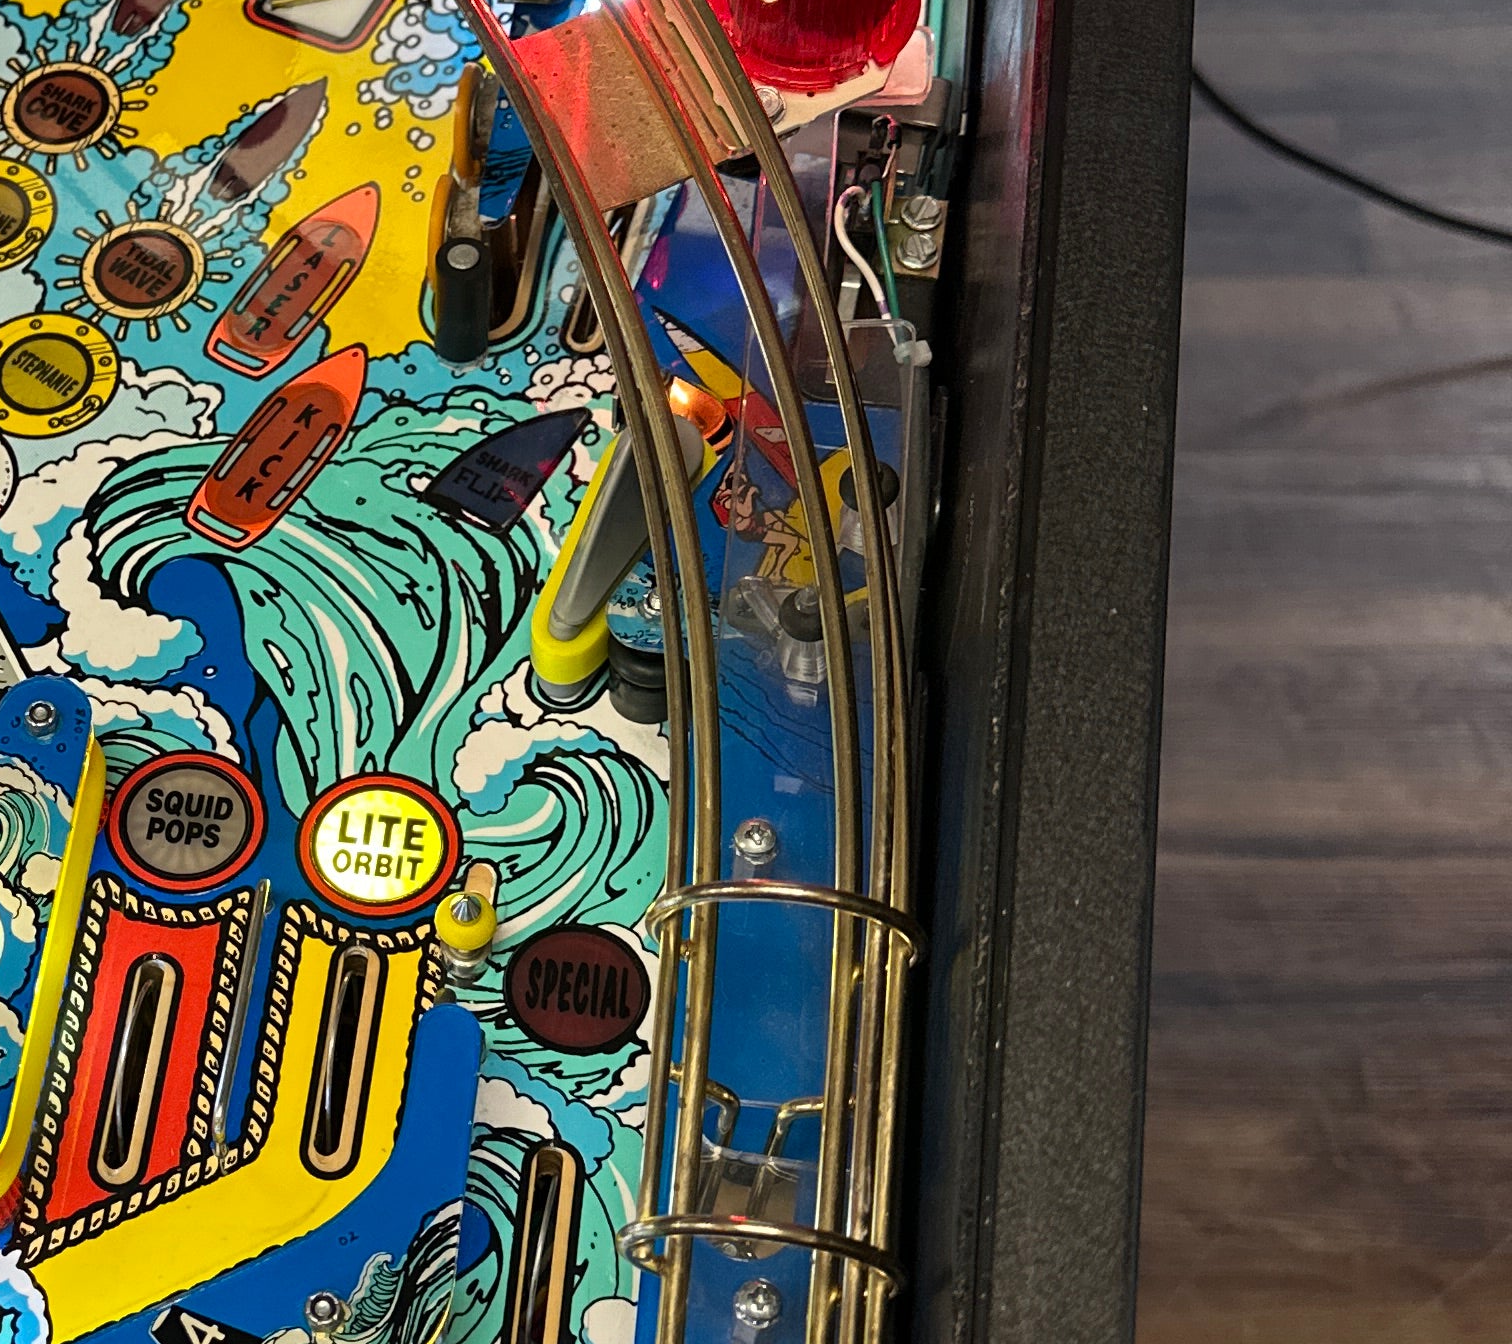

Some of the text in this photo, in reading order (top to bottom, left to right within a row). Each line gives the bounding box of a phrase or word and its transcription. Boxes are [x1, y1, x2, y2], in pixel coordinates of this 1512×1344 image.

[26, 96, 87, 133] COVE
[40, 82, 98, 112] SHARK
[109, 258, 170, 300] WAVE
[126, 242, 179, 281] TIDAL
[245, 223, 343, 342] LASER
[11, 349, 80, 399] STEPHANIE
[236, 403, 322, 503] KICK
[475, 451, 535, 488] SHARK
[454, 466, 516, 504] FLIP
[145, 788, 234, 822] SQUID
[145, 816, 221, 849] POPS
[338, 811, 426, 852] LITE
[332, 851, 425, 881] ORBIT
[525, 962, 633, 1020] SPECIAL
